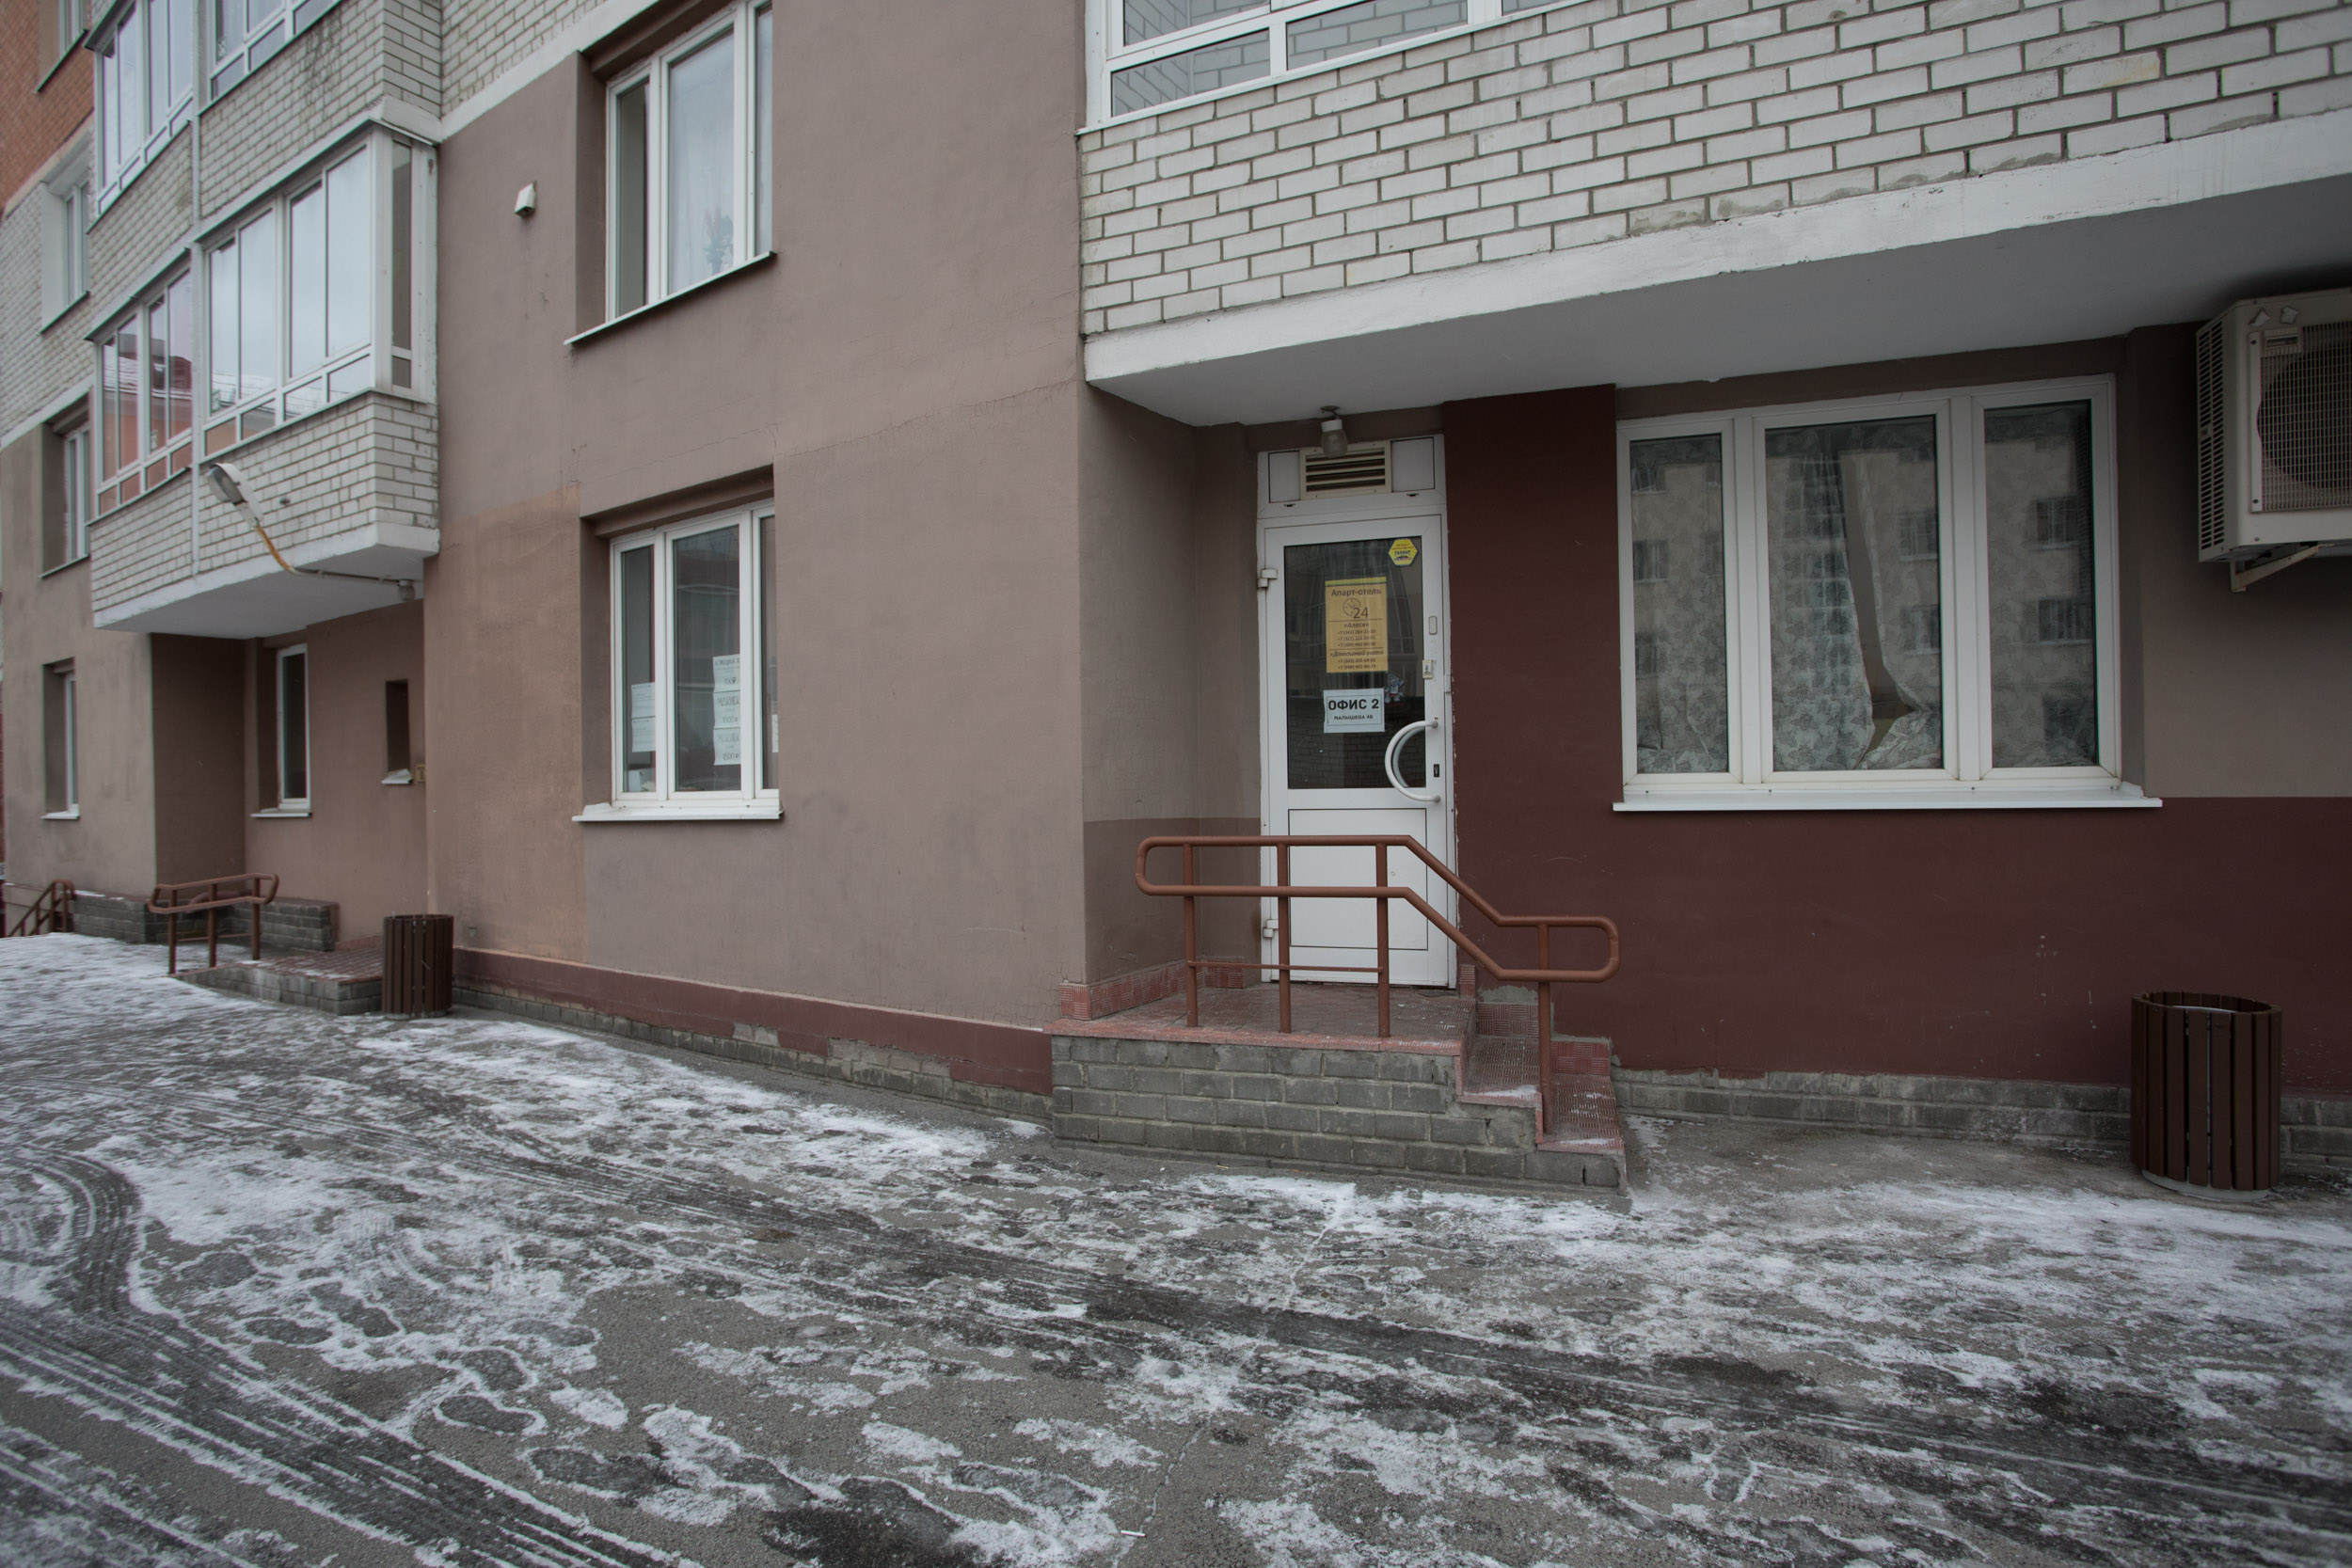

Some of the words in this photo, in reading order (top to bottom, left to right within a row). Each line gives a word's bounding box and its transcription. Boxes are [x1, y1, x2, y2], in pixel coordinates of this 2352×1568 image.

[1331, 588, 1382, 597] Апарт-отель
[1353, 607, 1369, 619] 24
[1328, 699, 1367, 710] ОФИС
[1372, 699, 1379, 709] 2
